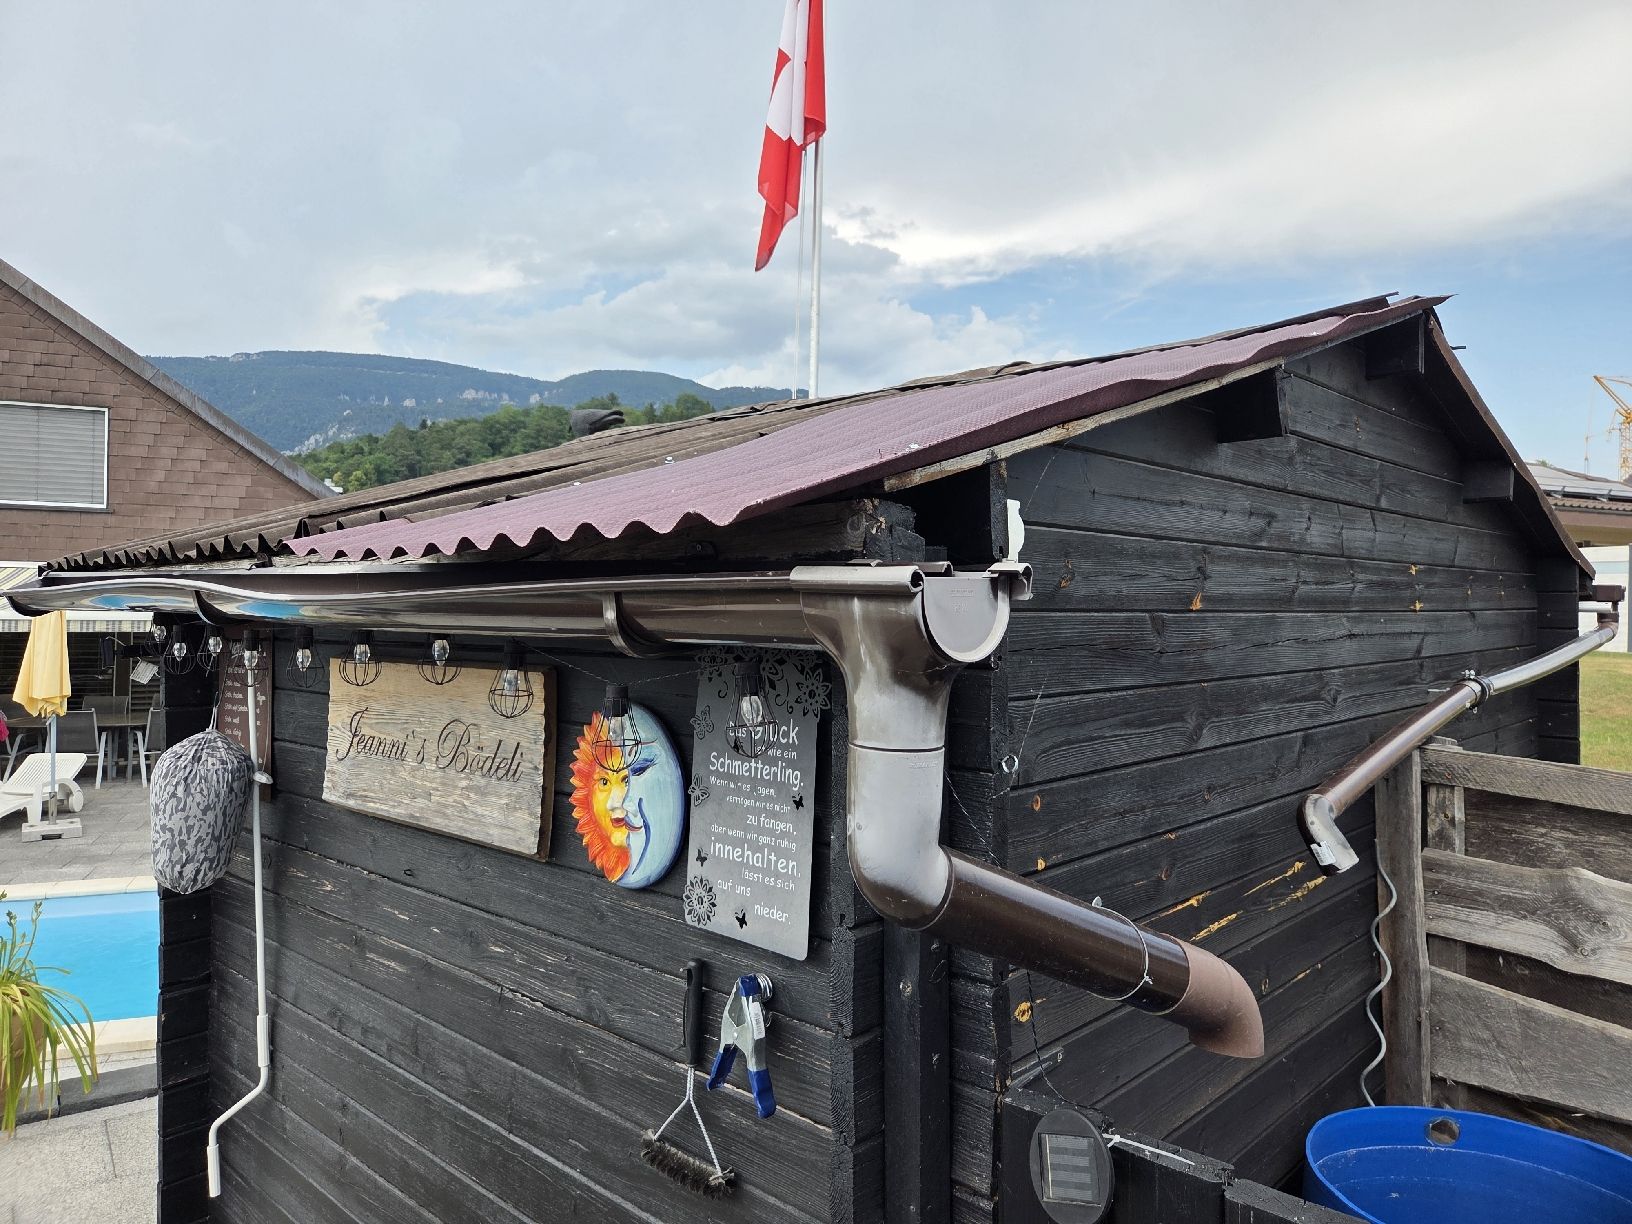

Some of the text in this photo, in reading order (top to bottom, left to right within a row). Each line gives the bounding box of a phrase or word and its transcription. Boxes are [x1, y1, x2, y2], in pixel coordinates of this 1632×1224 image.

[435, 718, 524, 783] Bödeli
[767, 746, 782, 757] wie
[783, 748, 797, 760] ein
[709, 751, 804, 791] Schmetterling.
[709, 775, 728, 787] Wenn
[742, 784, 751, 792] es
[774, 803, 791, 813] nicht
[746, 814, 758, 825] zu
[710, 822, 797, 853] aber wenn wir ganz ruhig
[717, 879, 751, 897] auf uns
[741, 866, 795, 892] lässt es sich
[754, 901, 791, 925] nieder.
